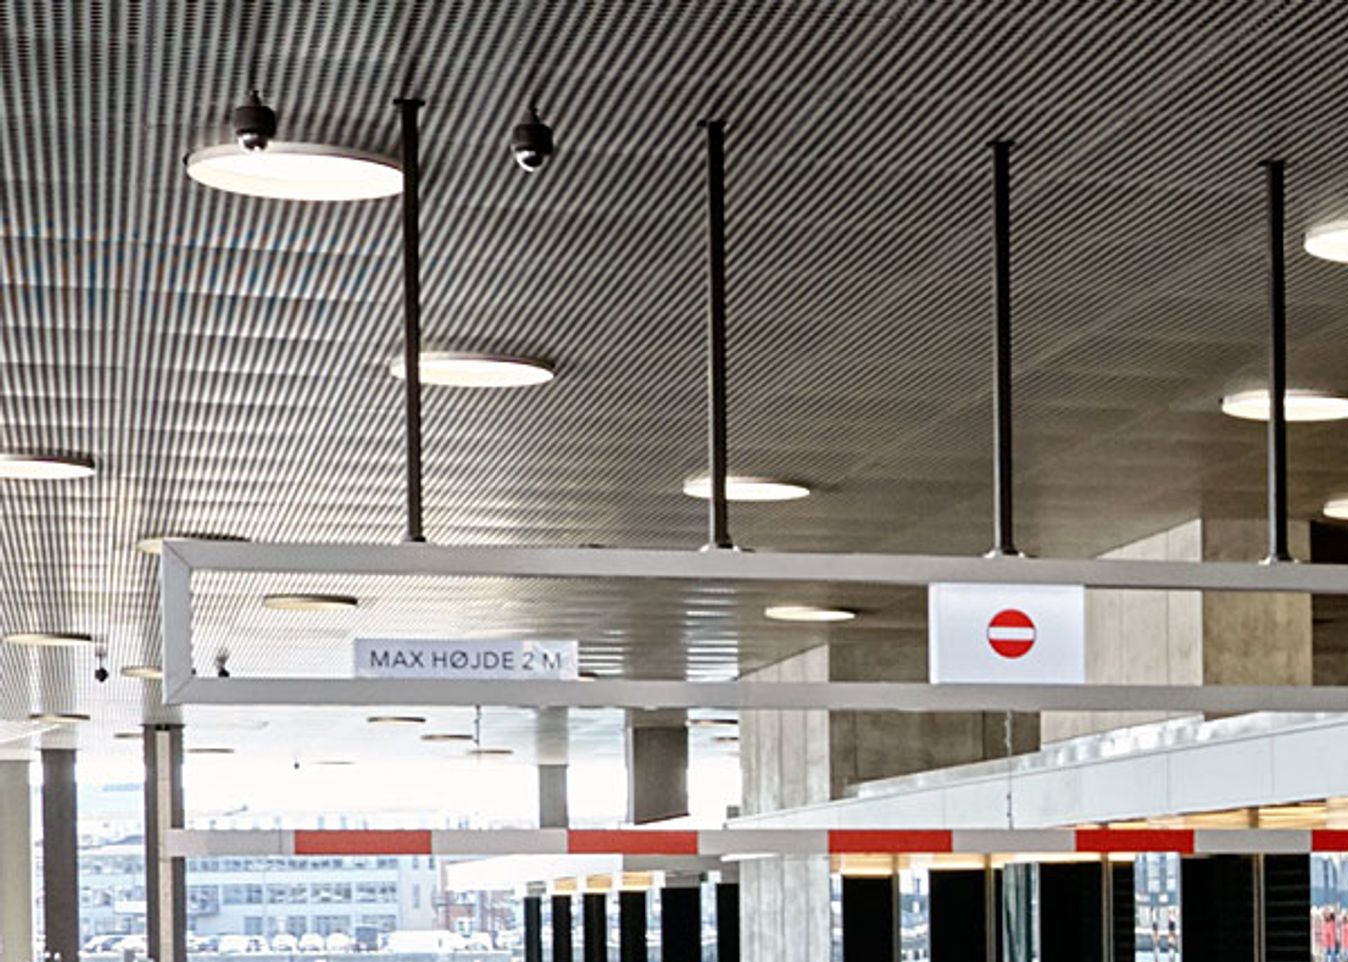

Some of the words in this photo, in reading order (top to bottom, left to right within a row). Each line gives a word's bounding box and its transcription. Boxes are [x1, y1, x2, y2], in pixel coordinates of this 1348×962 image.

[370, 650, 424, 669] MAX
[432, 650, 514, 670] HØJDE
[522, 652, 534, 670] 2
[542, 652, 561, 669] M
